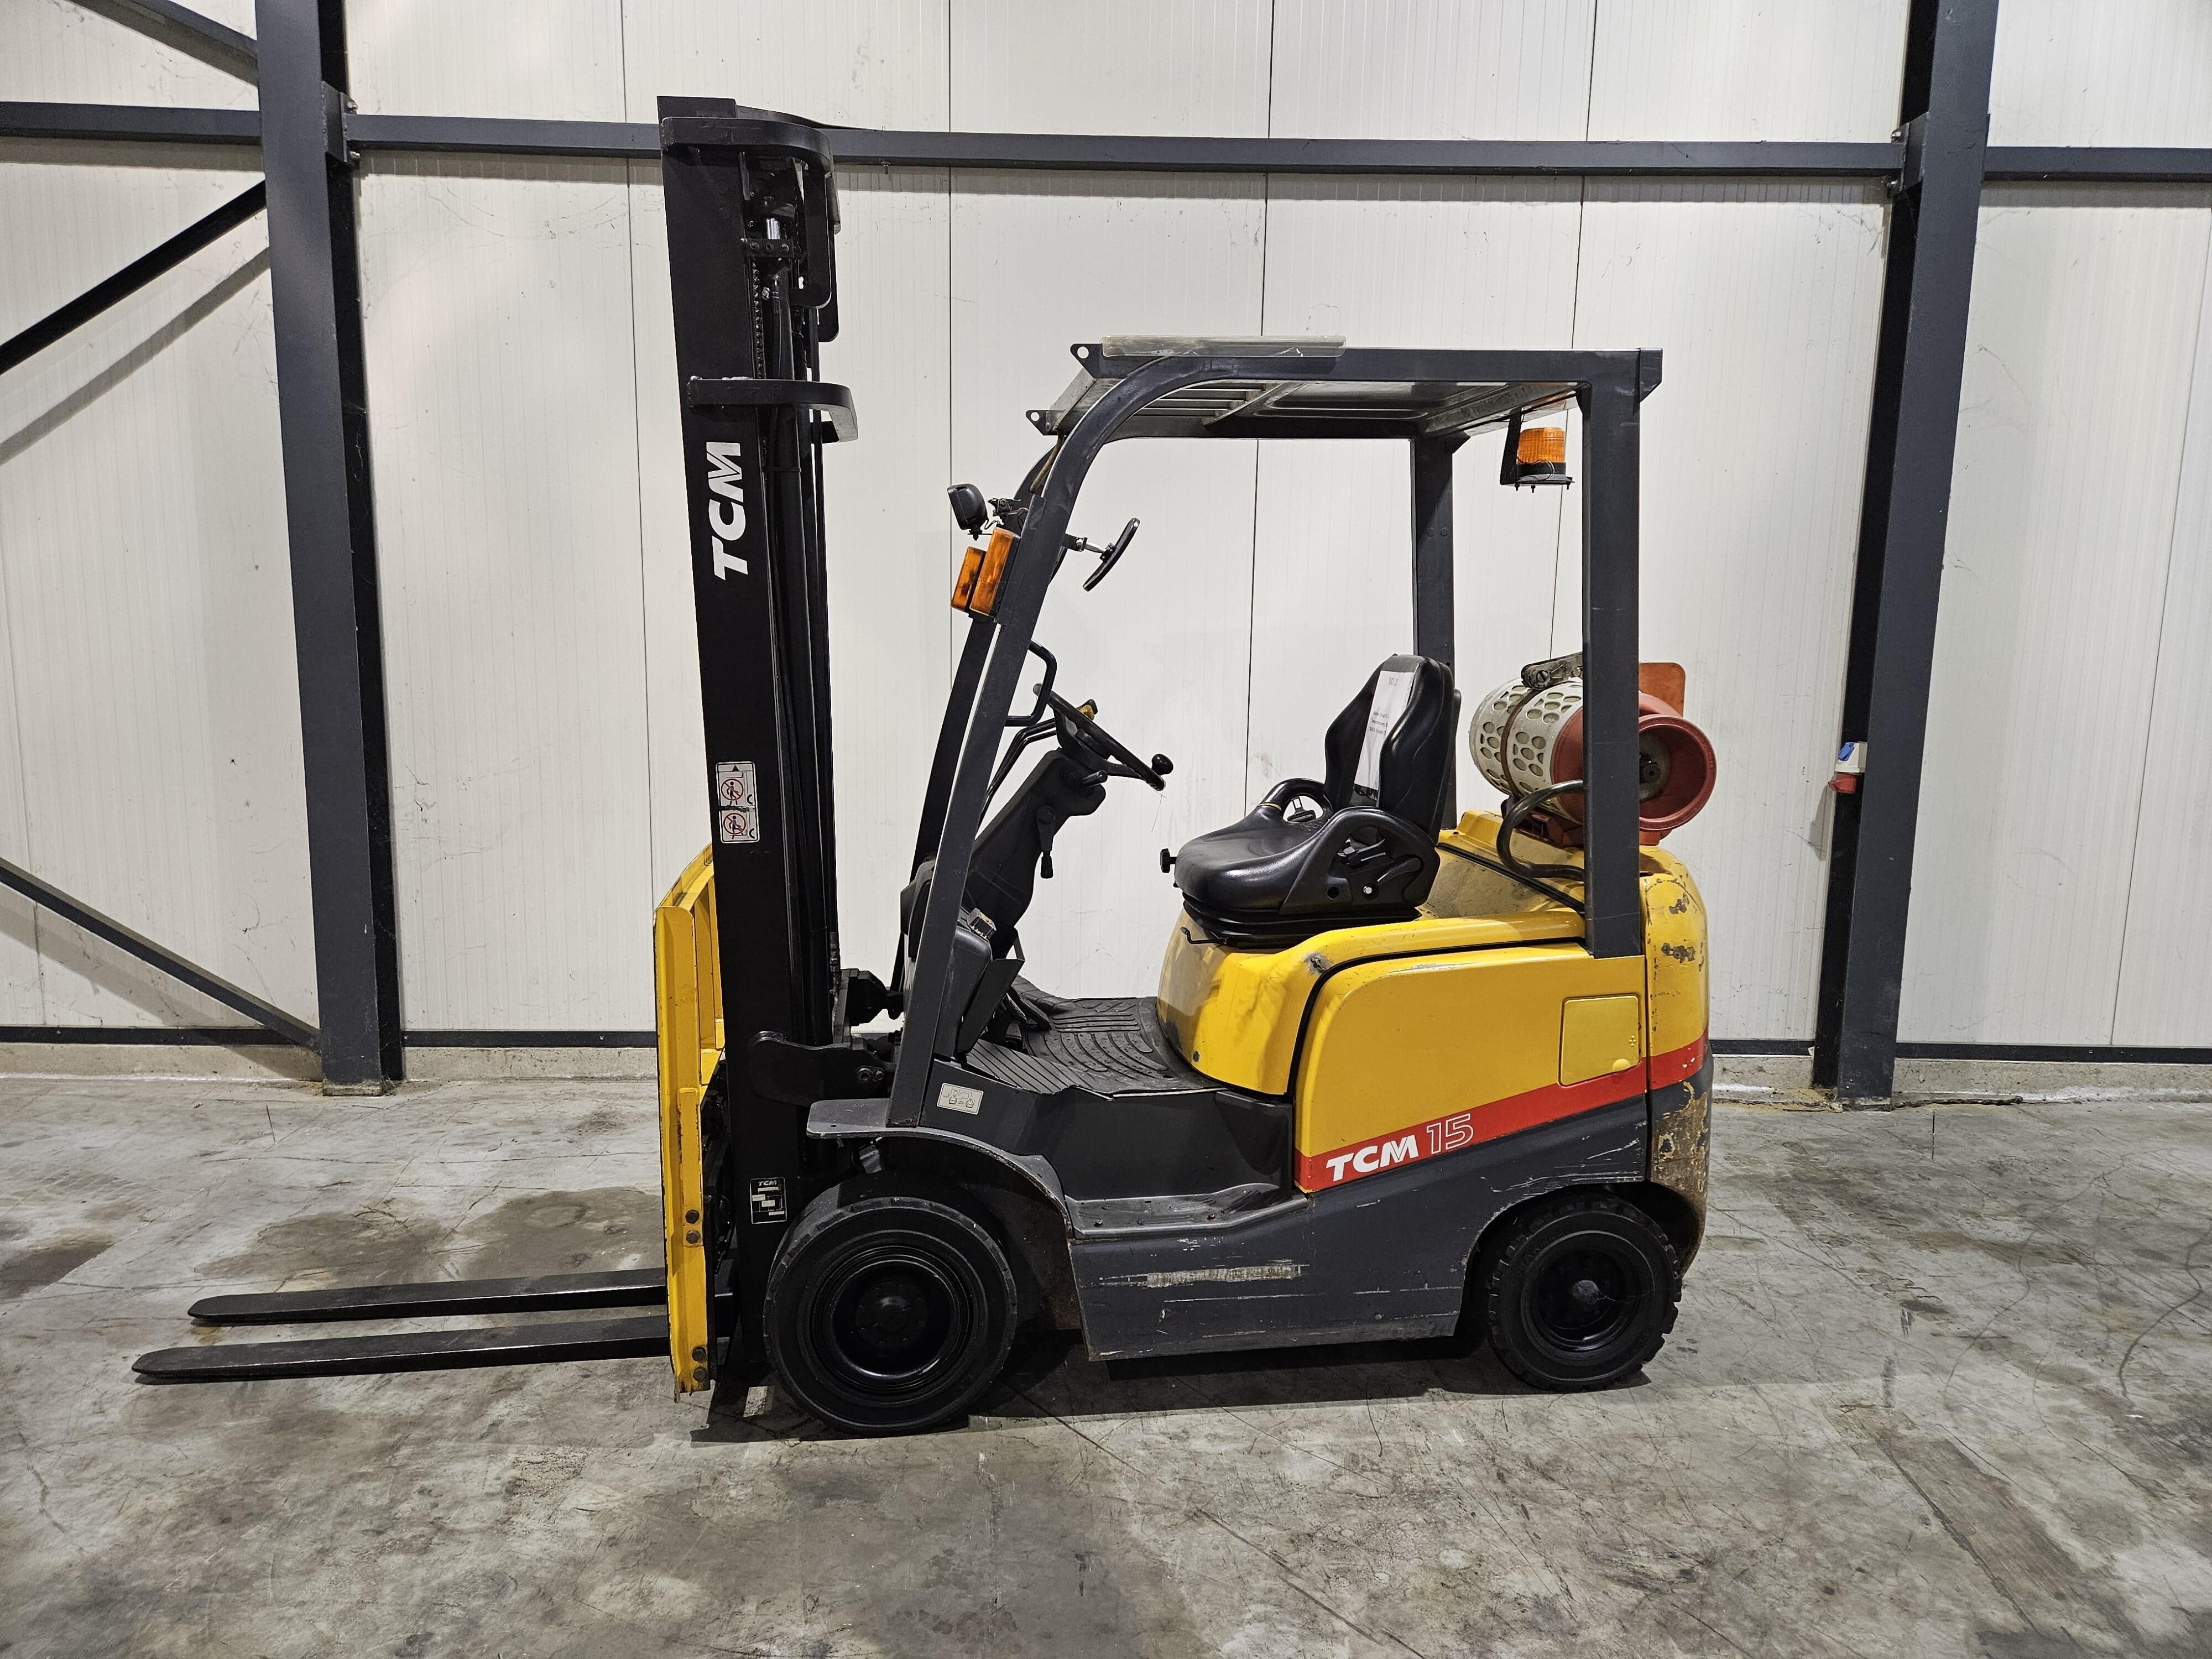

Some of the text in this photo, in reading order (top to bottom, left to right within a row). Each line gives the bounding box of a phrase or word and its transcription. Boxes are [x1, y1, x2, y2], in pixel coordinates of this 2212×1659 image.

[706, 441, 748, 581] TCM
[1326, 1113, 1474, 1182] TCM 15
